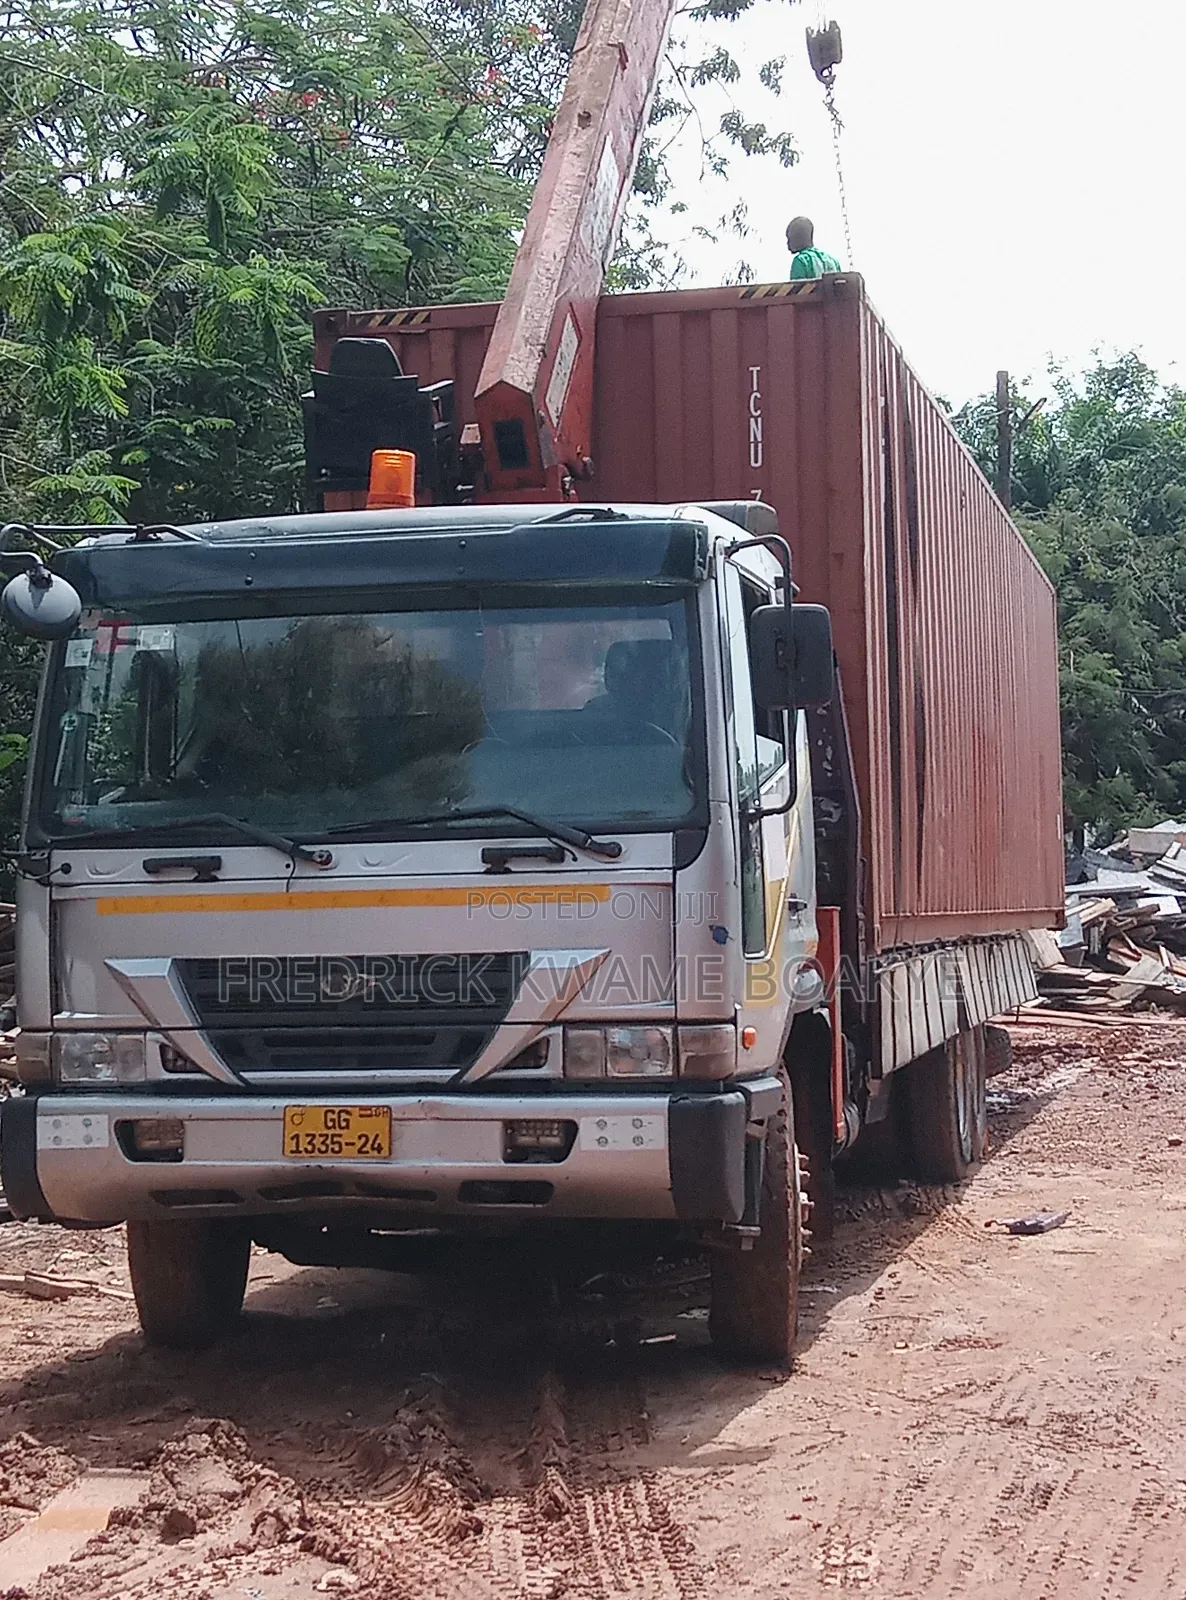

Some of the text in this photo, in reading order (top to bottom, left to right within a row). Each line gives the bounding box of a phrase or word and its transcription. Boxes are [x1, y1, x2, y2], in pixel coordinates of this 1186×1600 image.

[749, 366, 763, 468] TCNU
[323, 1109, 352, 1130] GG
[289, 1132, 384, 1155] 1335-24
